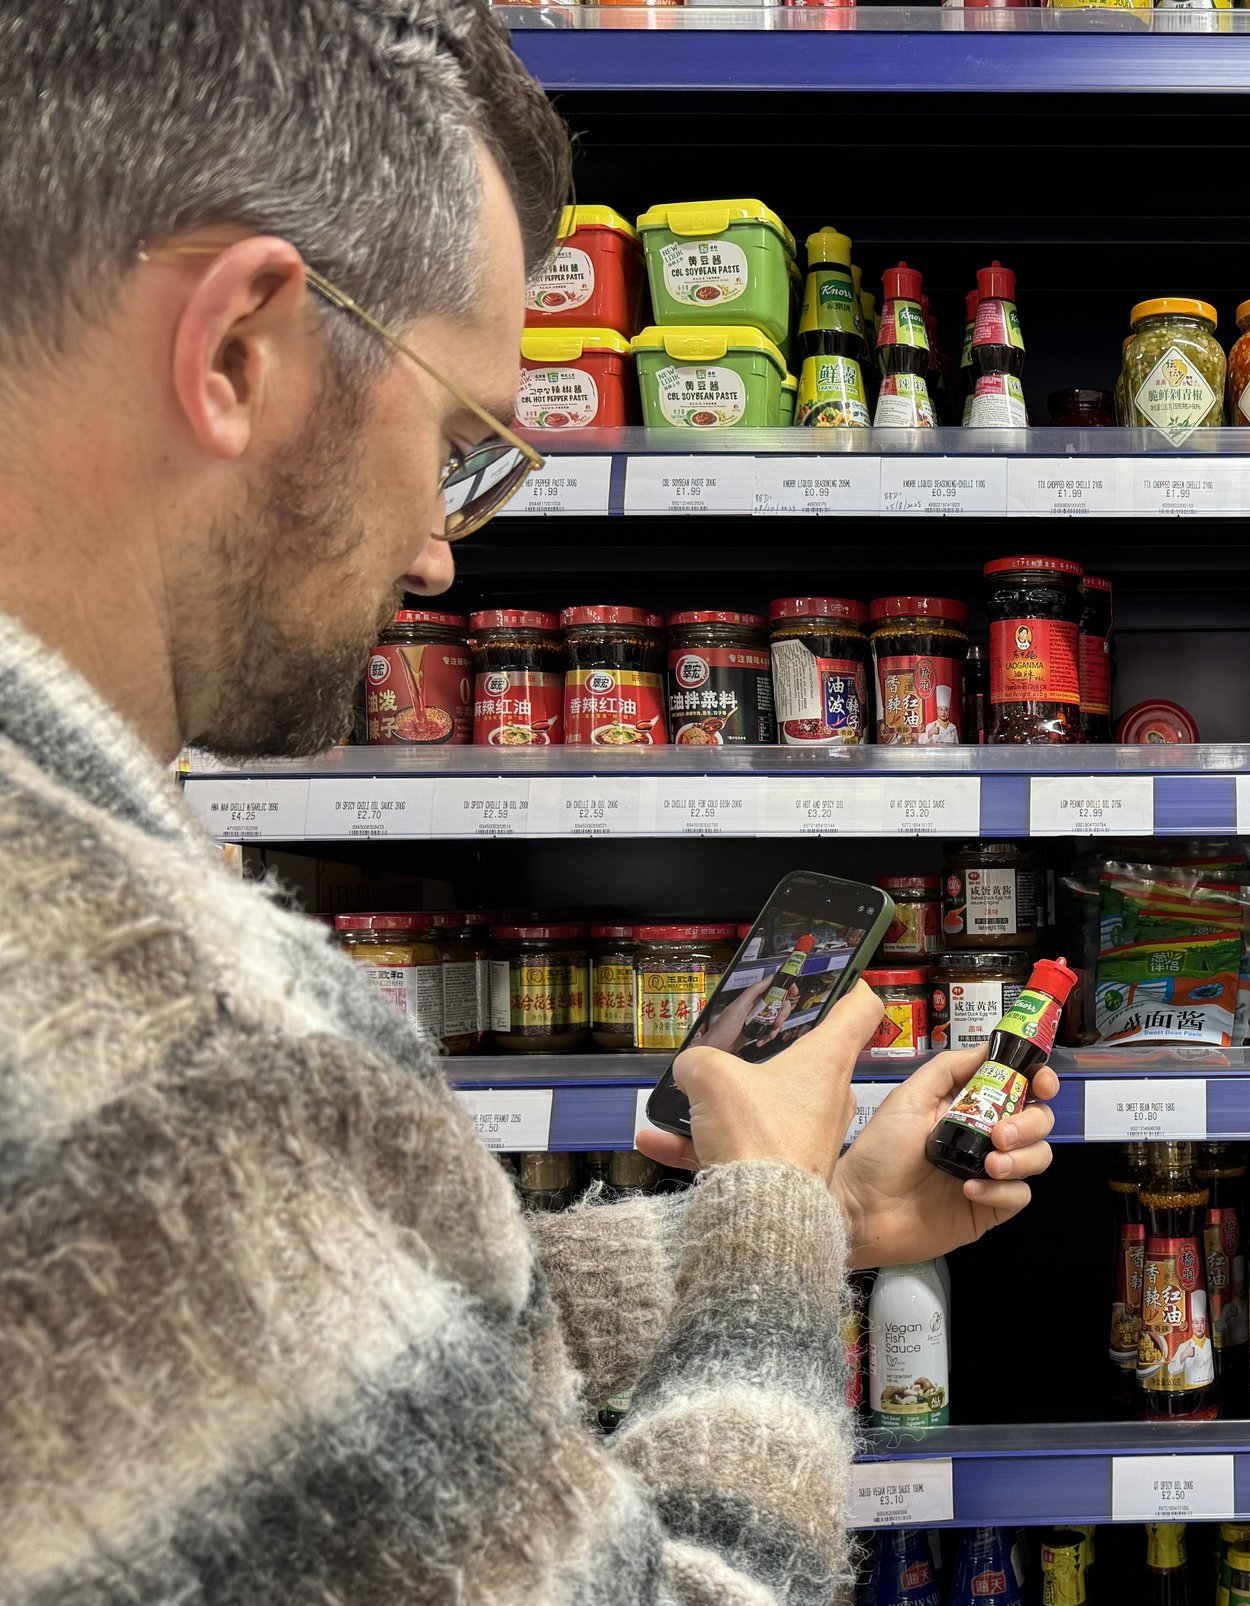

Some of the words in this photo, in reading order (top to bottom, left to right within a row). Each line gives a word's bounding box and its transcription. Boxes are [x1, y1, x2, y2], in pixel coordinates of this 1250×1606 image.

[685, 266, 717, 276] SOYBEAN
[718, 264, 740, 274] PASTE
[566, 272, 585, 281] PASTE
[820, 284, 852, 300] Knorr
[548, 394, 568, 402] PEPPER
[569, 393, 589, 402] PASTE
[682, 392, 714, 400] SOYBEAN
[716, 391, 739, 400] PASTE
[550, 479, 565, 487] PASTE
[690, 479, 704, 487] PASTE
[533, 487, 558, 496] £1.99
[676, 487, 701, 496] £1.99
[804, 488, 830, 497] £0.99
[932, 488, 956, 497] £0.99
[1058, 489, 1082, 498] £1.99
[1166, 489, 1190, 498] £1.99
[570, 698, 636, 715] 香辣红油
[232, 811, 256, 821] £4.25
[357, 810, 381, 819] £2.70
[484, 809, 508, 818] £2.59
[579, 809, 604, 818] £2.59
[690, 809, 715, 817] £2.59
[808, 809, 832, 818] £3.20
[905, 808, 929, 817] £3.20
[1079, 808, 1103, 817] £2.99
[954, 1001, 997, 1012] 咸蛋黄酱
[1134, 1112, 1157, 1121] £0.80
[884, 1322, 922, 1336] Vegan
[886, 1333, 906, 1344] Fish
[886, 1344, 921, 1354] Sauce
[1162, 1490, 1185, 1500] £2.50
[880, 1495, 904, 1505] £3.10
